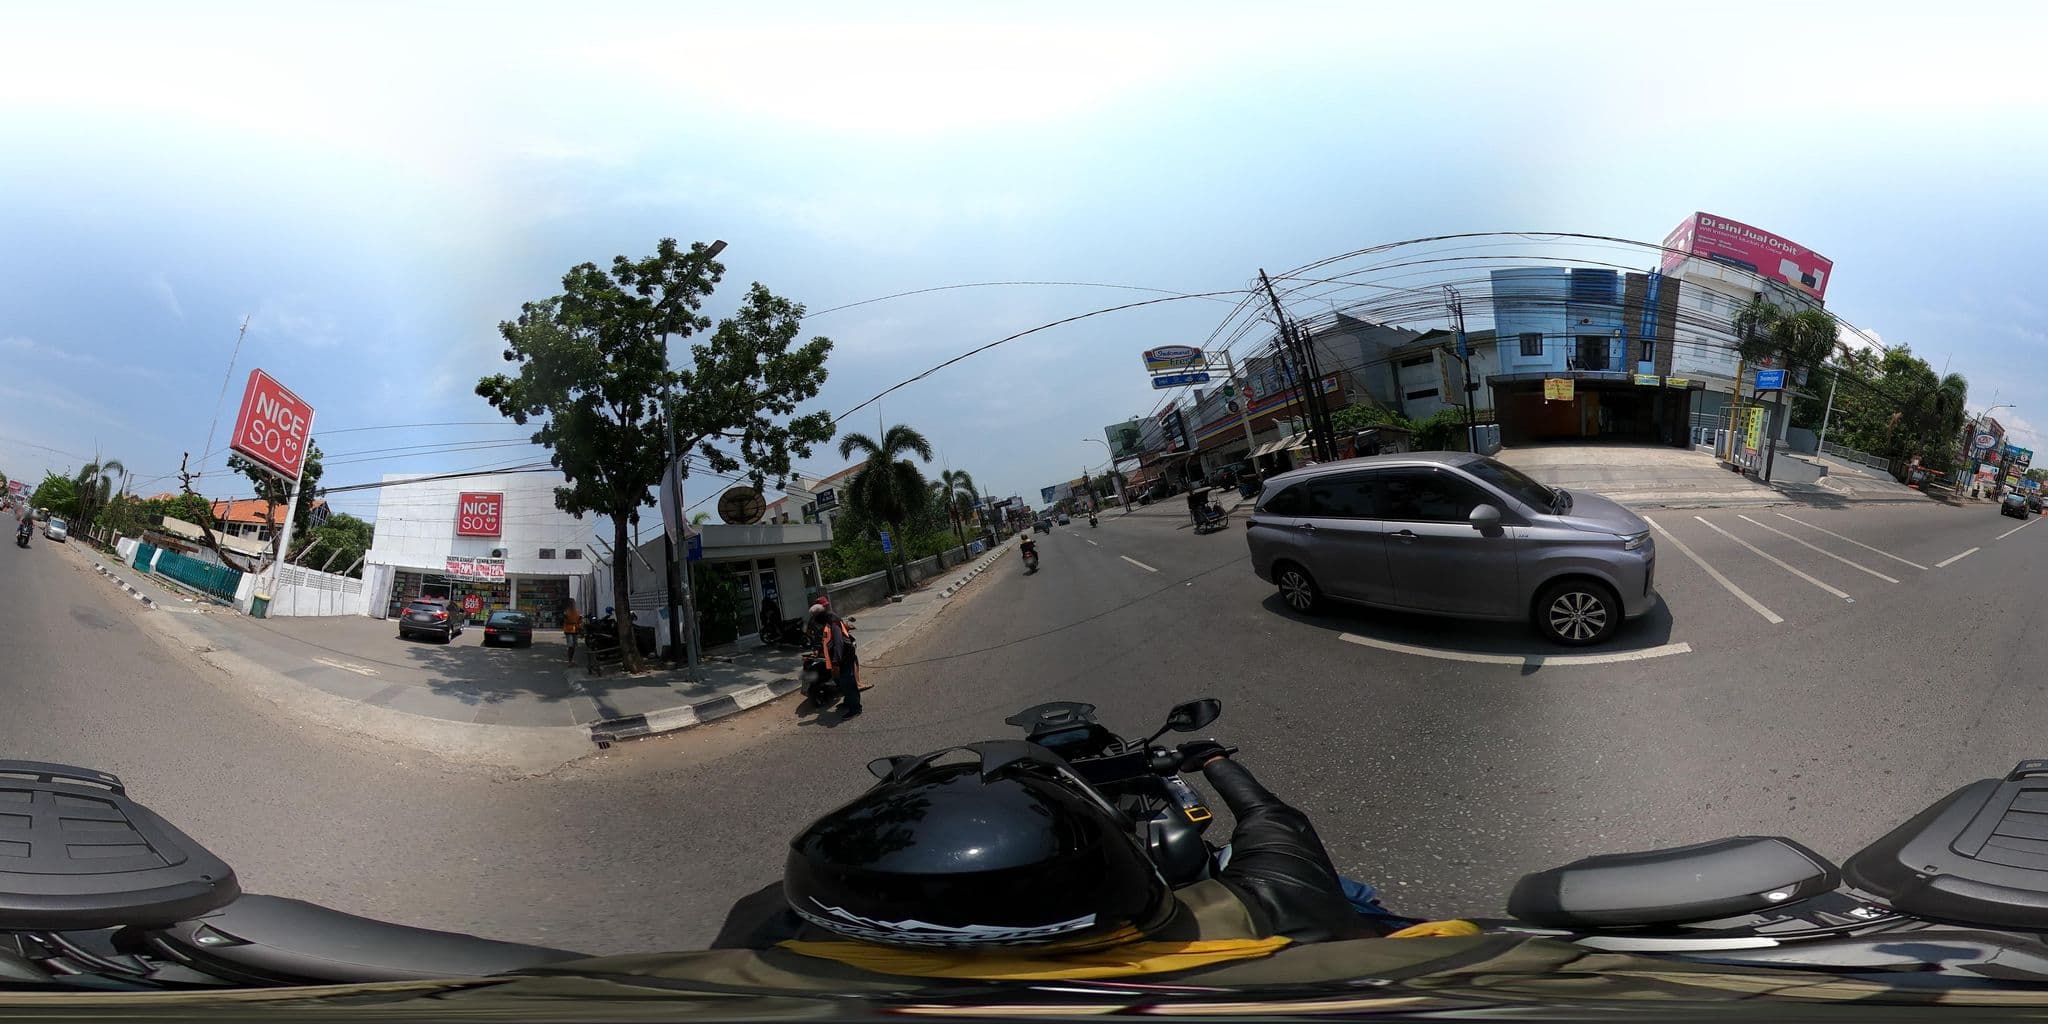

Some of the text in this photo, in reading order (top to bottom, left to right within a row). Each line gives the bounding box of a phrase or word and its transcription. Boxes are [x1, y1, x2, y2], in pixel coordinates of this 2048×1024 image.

[1701, 217, 1798, 256] Di sini Jual Orbit
[256, 391, 305, 440] NICE
[1748, 410, 1756, 447] HOTEL
[463, 502, 498, 516] NICE
